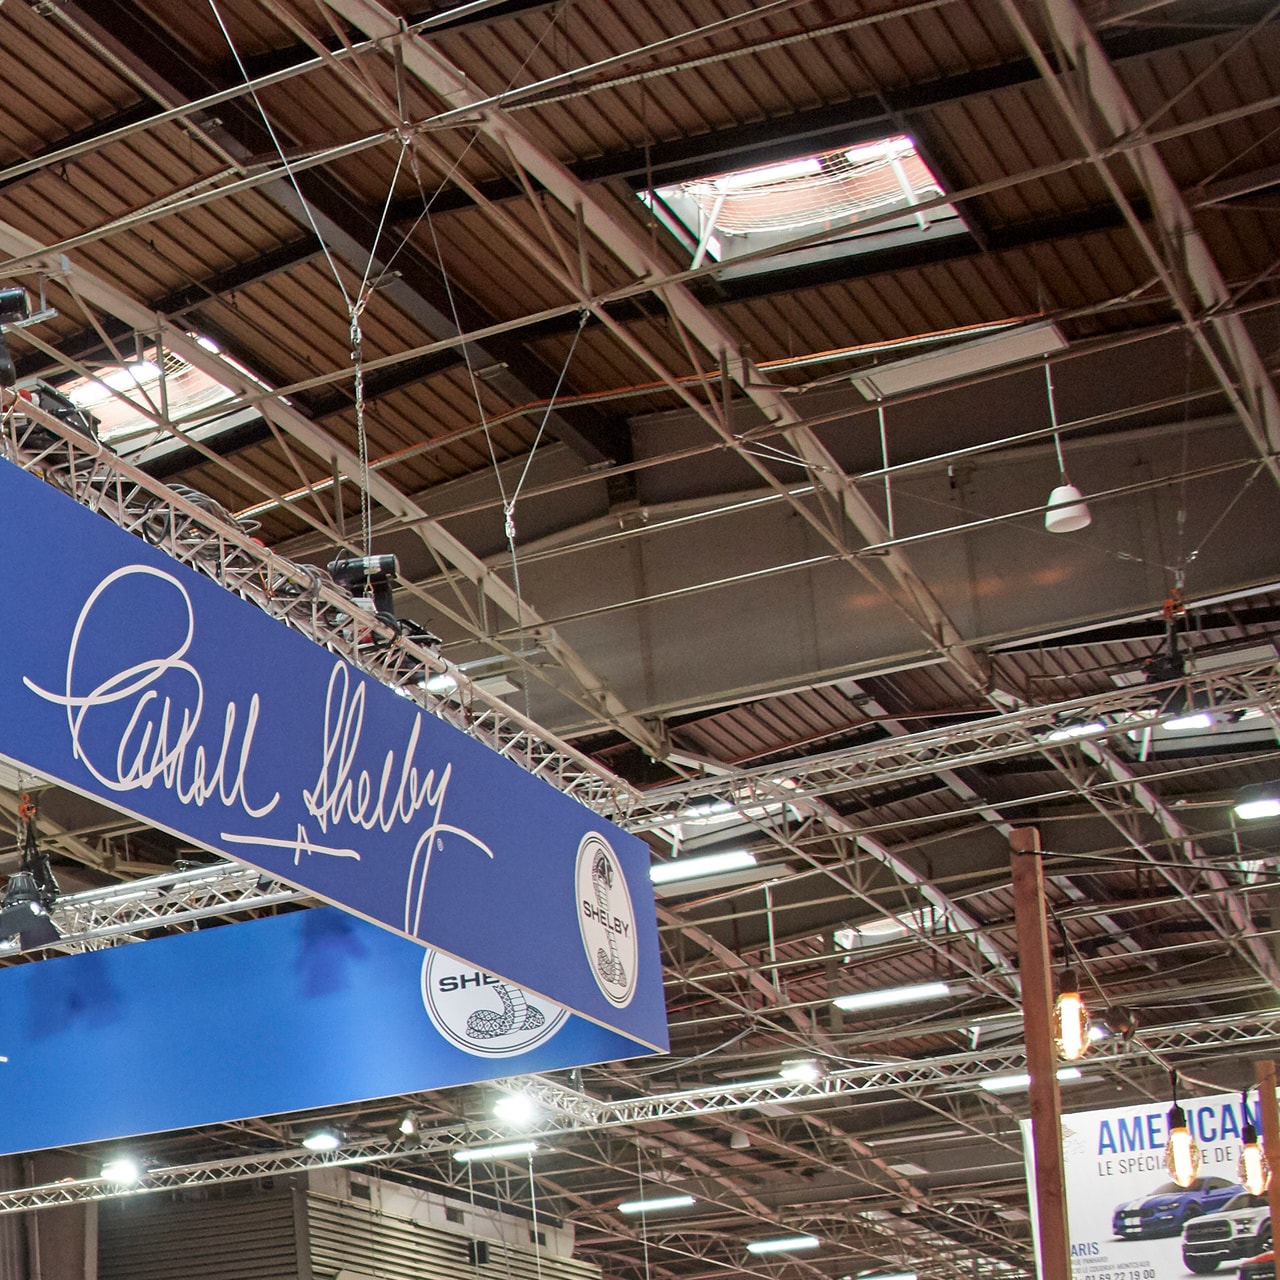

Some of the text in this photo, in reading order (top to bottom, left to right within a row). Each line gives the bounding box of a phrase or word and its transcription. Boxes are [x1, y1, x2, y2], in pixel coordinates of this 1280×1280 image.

[583, 900, 630, 938] SHELBY
[439, 972, 500, 993] SHE
[1098, 1101, 1263, 1156] AMEICAN
[1098, 1161, 1112, 1177] LE
[1216, 1146, 1232, 1163] DE
[1071, 1242, 1100, 1257] ARIS
[1129, 1270, 1140, 1280] 19
[1143, 1269, 1155, 1280] 00
